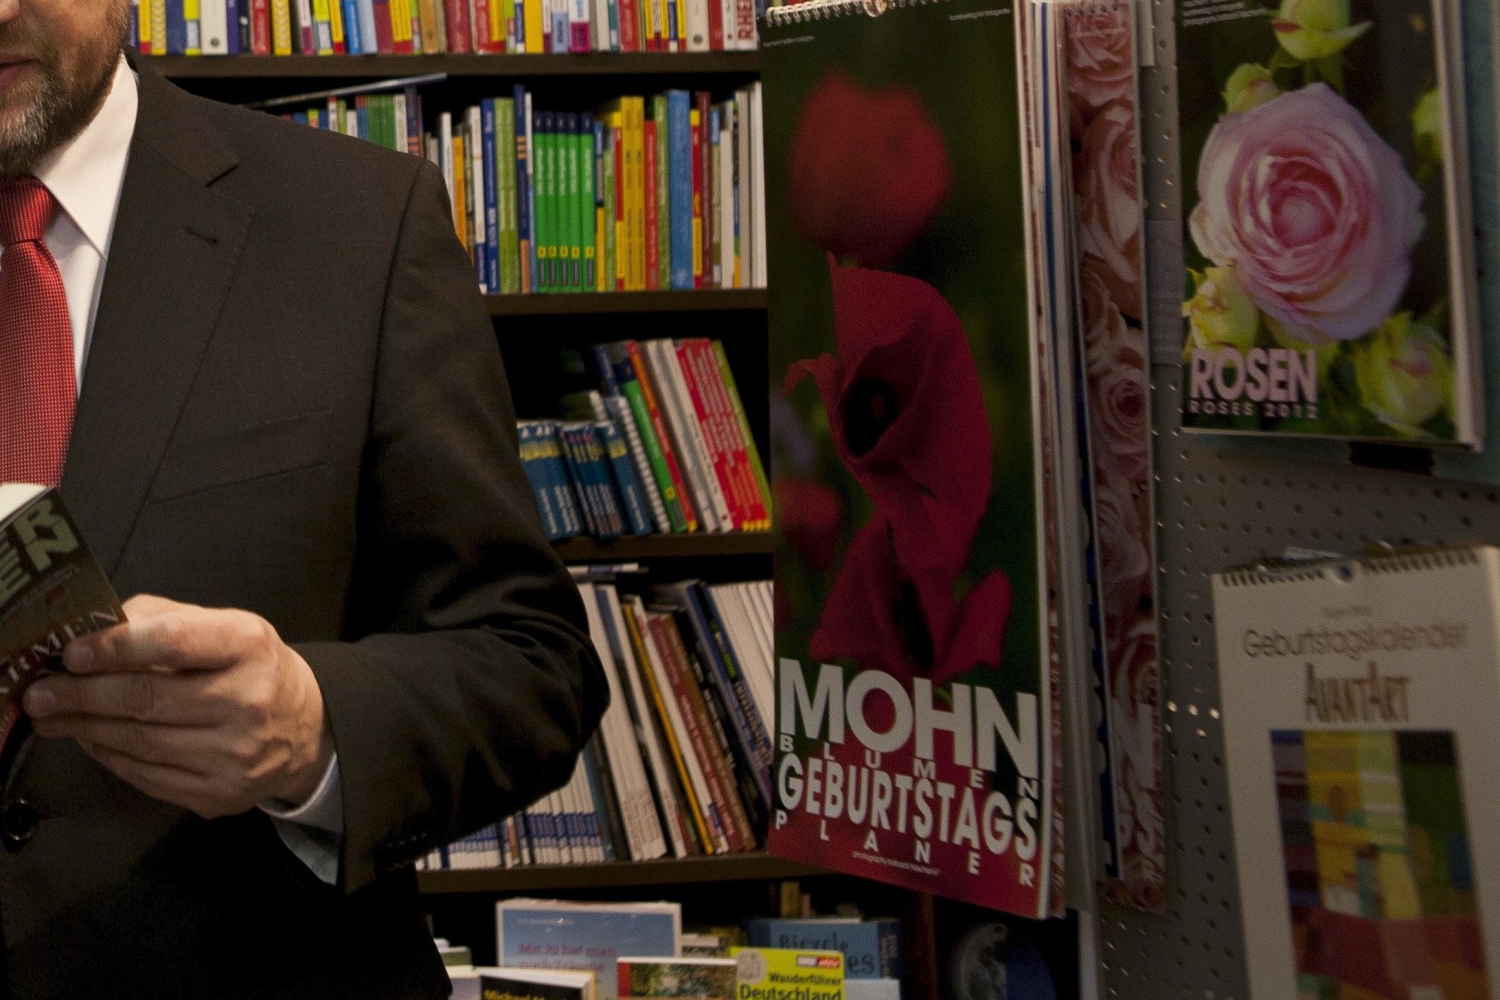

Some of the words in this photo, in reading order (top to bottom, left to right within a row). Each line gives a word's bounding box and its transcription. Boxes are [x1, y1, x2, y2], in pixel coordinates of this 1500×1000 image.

[1190, 347, 1318, 402] ROSEN
[1189, 401, 1254, 417] ROSES
[778, 657, 1039, 779] MOHN
[778, 733, 1039, 800] BLUMEN
[778, 752, 1038, 860] GEBURTSTAGS
[774, 808, 1035, 887] PLANER
[740, 984, 842, 1000] Deutschland
[770, 972, 842, 985] Wanderführer
